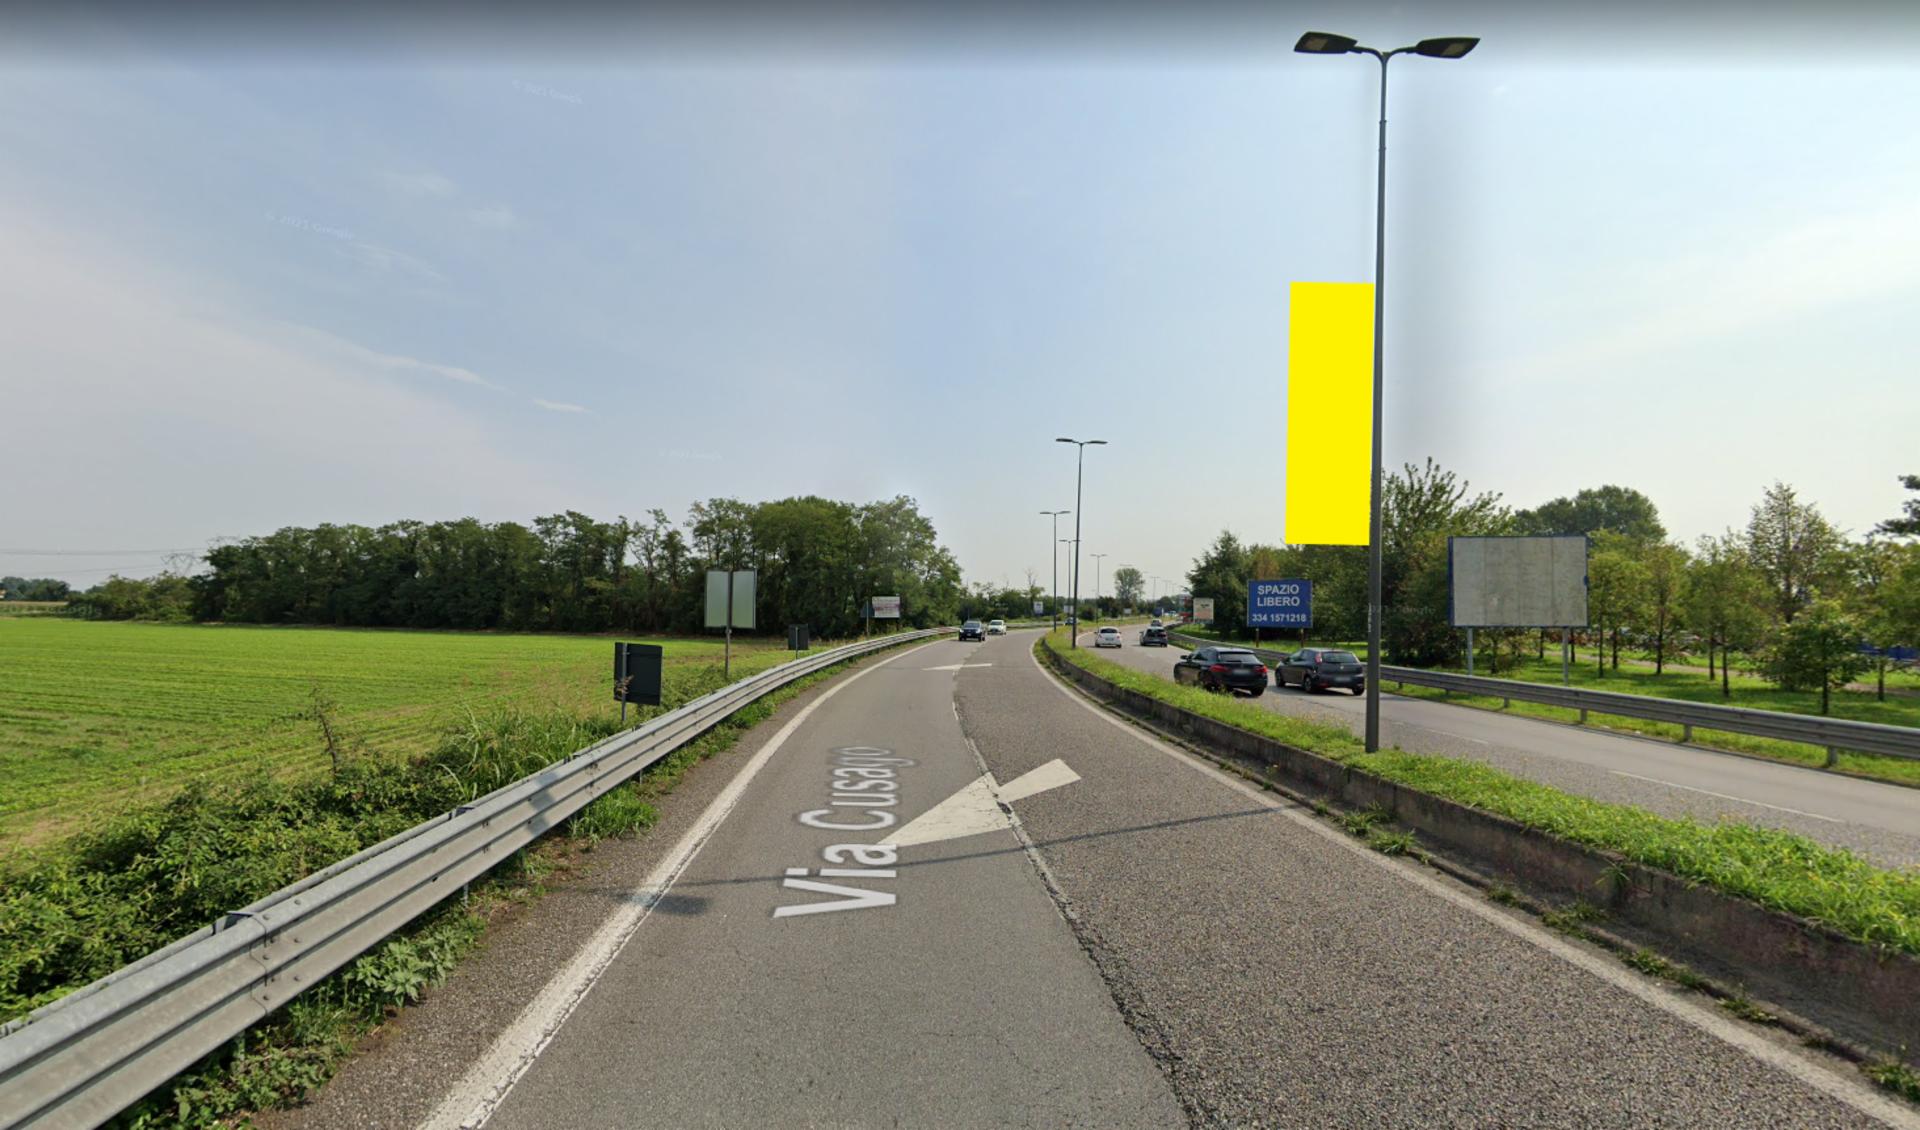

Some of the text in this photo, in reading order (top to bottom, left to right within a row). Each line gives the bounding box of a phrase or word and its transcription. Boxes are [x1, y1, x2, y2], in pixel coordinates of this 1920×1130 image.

[1257, 584, 1300, 595] SPAZIO
[1257, 596, 1300, 607] LIBERO
[1251, 613, 1306, 622] 334 1571218
